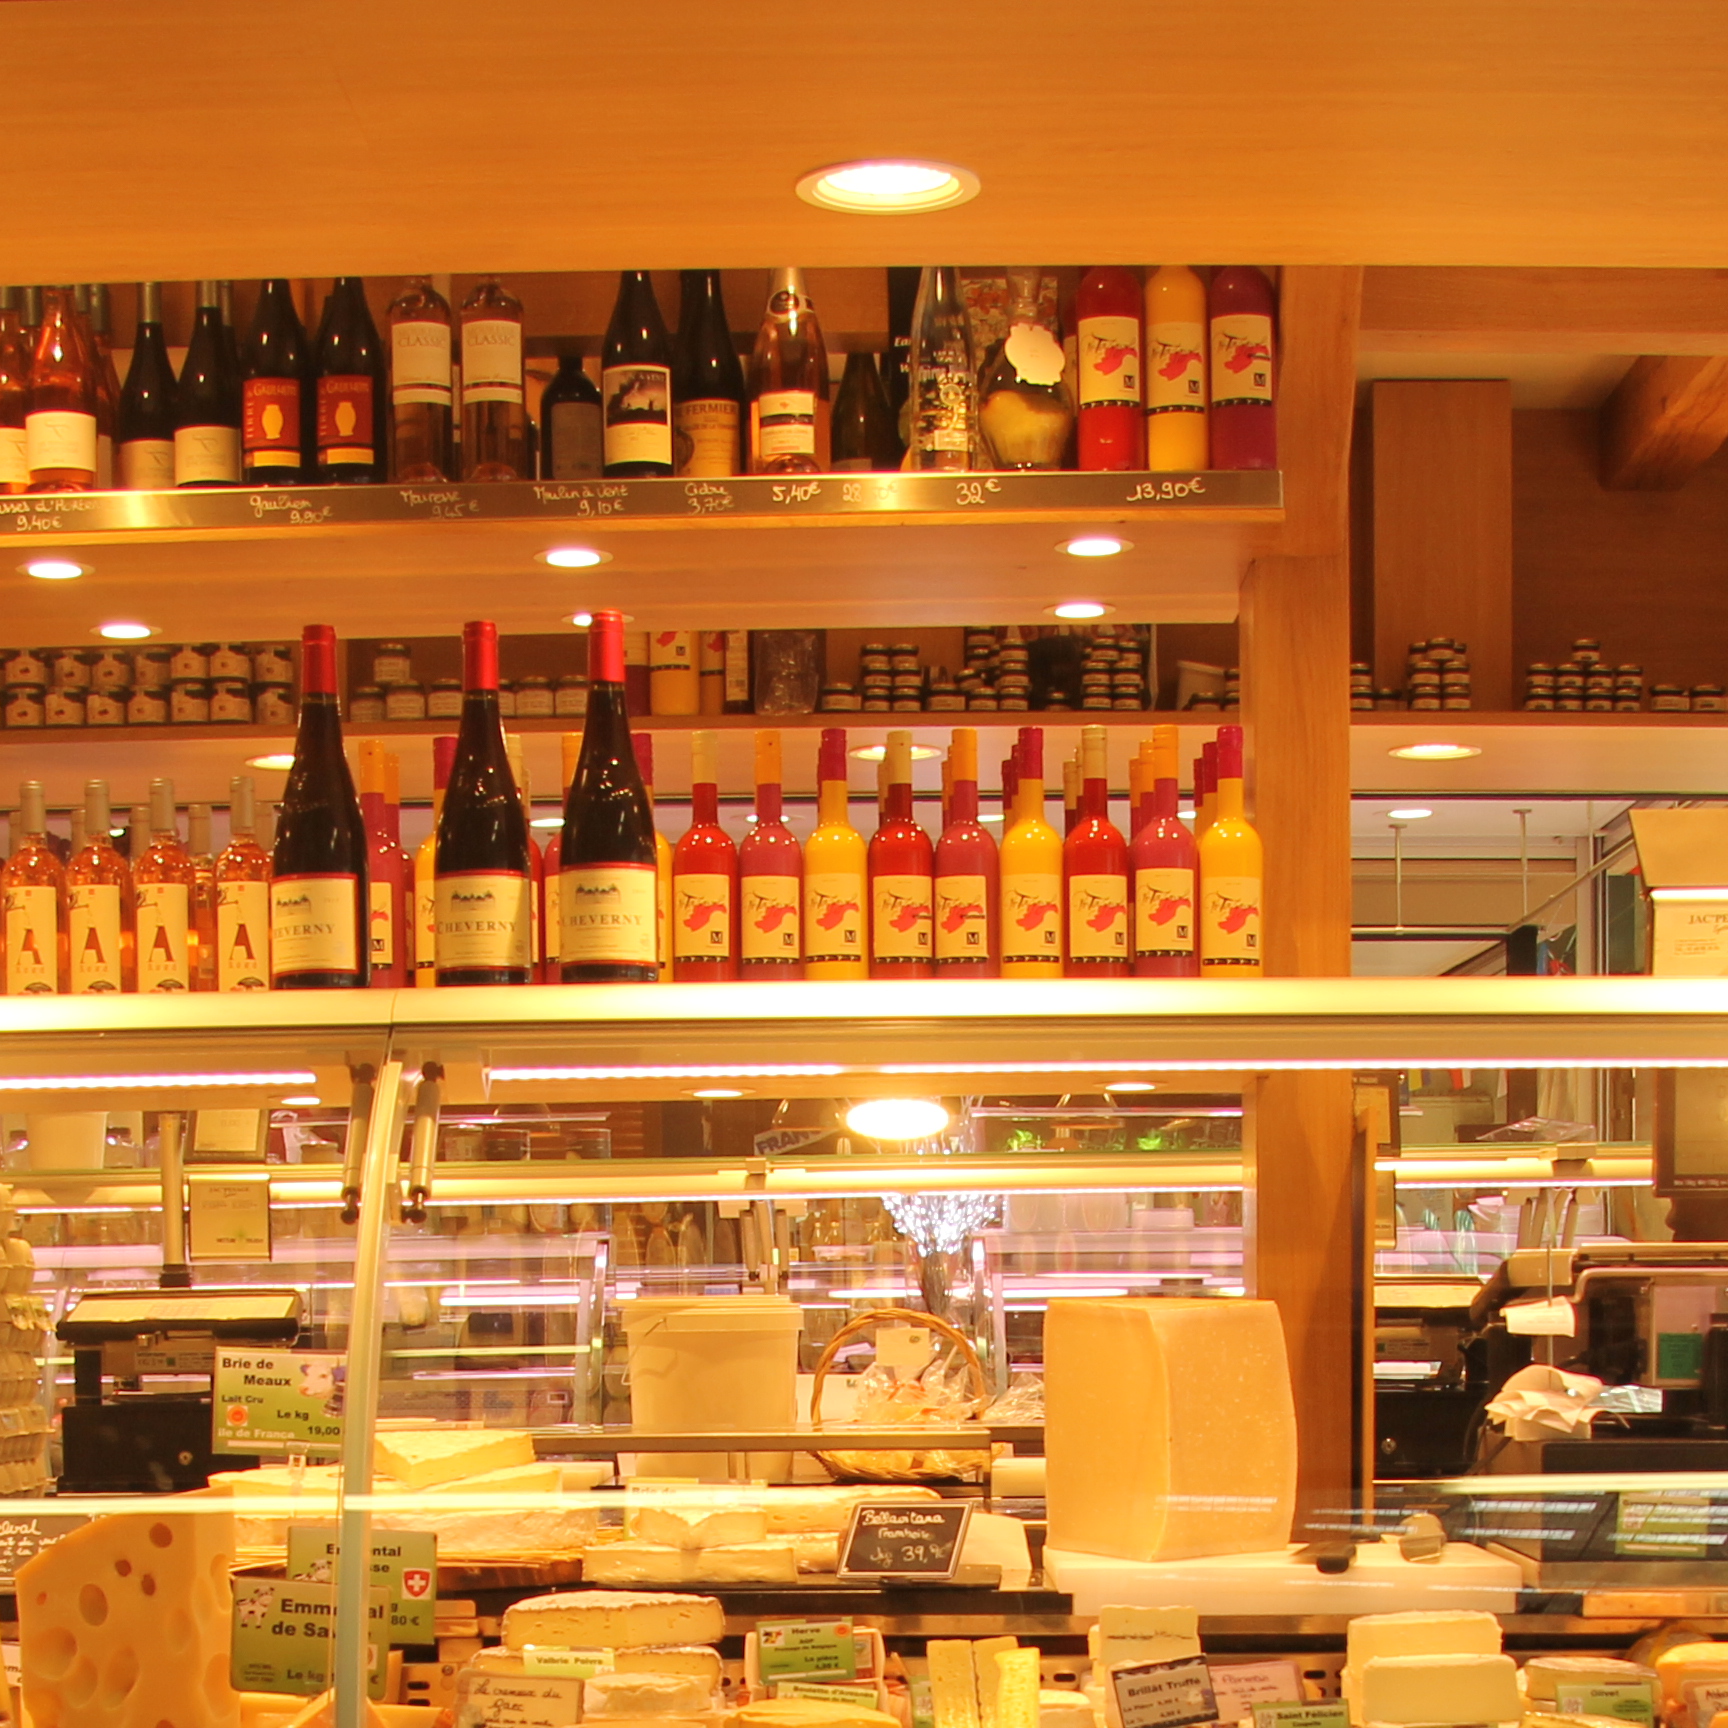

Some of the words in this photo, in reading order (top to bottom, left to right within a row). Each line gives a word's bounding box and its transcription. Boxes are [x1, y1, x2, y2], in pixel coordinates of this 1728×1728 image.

[467, 335, 514, 347] CLASSIC
[685, 483, 729, 496] Cidre
[955, 478, 1002, 505] 32€
[1126, 477, 1206, 501] 13,90€
[562, 913, 643, 928] CHEVERNY
[437, 920, 517, 934] CHEVERNY
[223, 1357, 251, 1369] Brie
[256, 1358, 274, 1370] de
[244, 1374, 291, 1386] Meaux
[222, 1394, 241, 1403] Lait
[245, 1394, 264, 1404] Cru
[277, 1409, 291, 1419] Le
[295, 1409, 309, 1421] kg
[236, 1428, 250, 1438] de
[254, 1428, 295, 1439] France
[308, 1425, 340, 1436] 19,00
[326, 1543, 402, 1557] Ental
[281, 1598, 384, 1619] Emmal
[272, 1621, 296, 1636] de
[791, 1626, 821, 1635] Herve
[536, 1656, 569, 1665] Valbrie
[287, 1669, 302, 1680] Le
[1277, 1712, 1302, 1720] Saint
